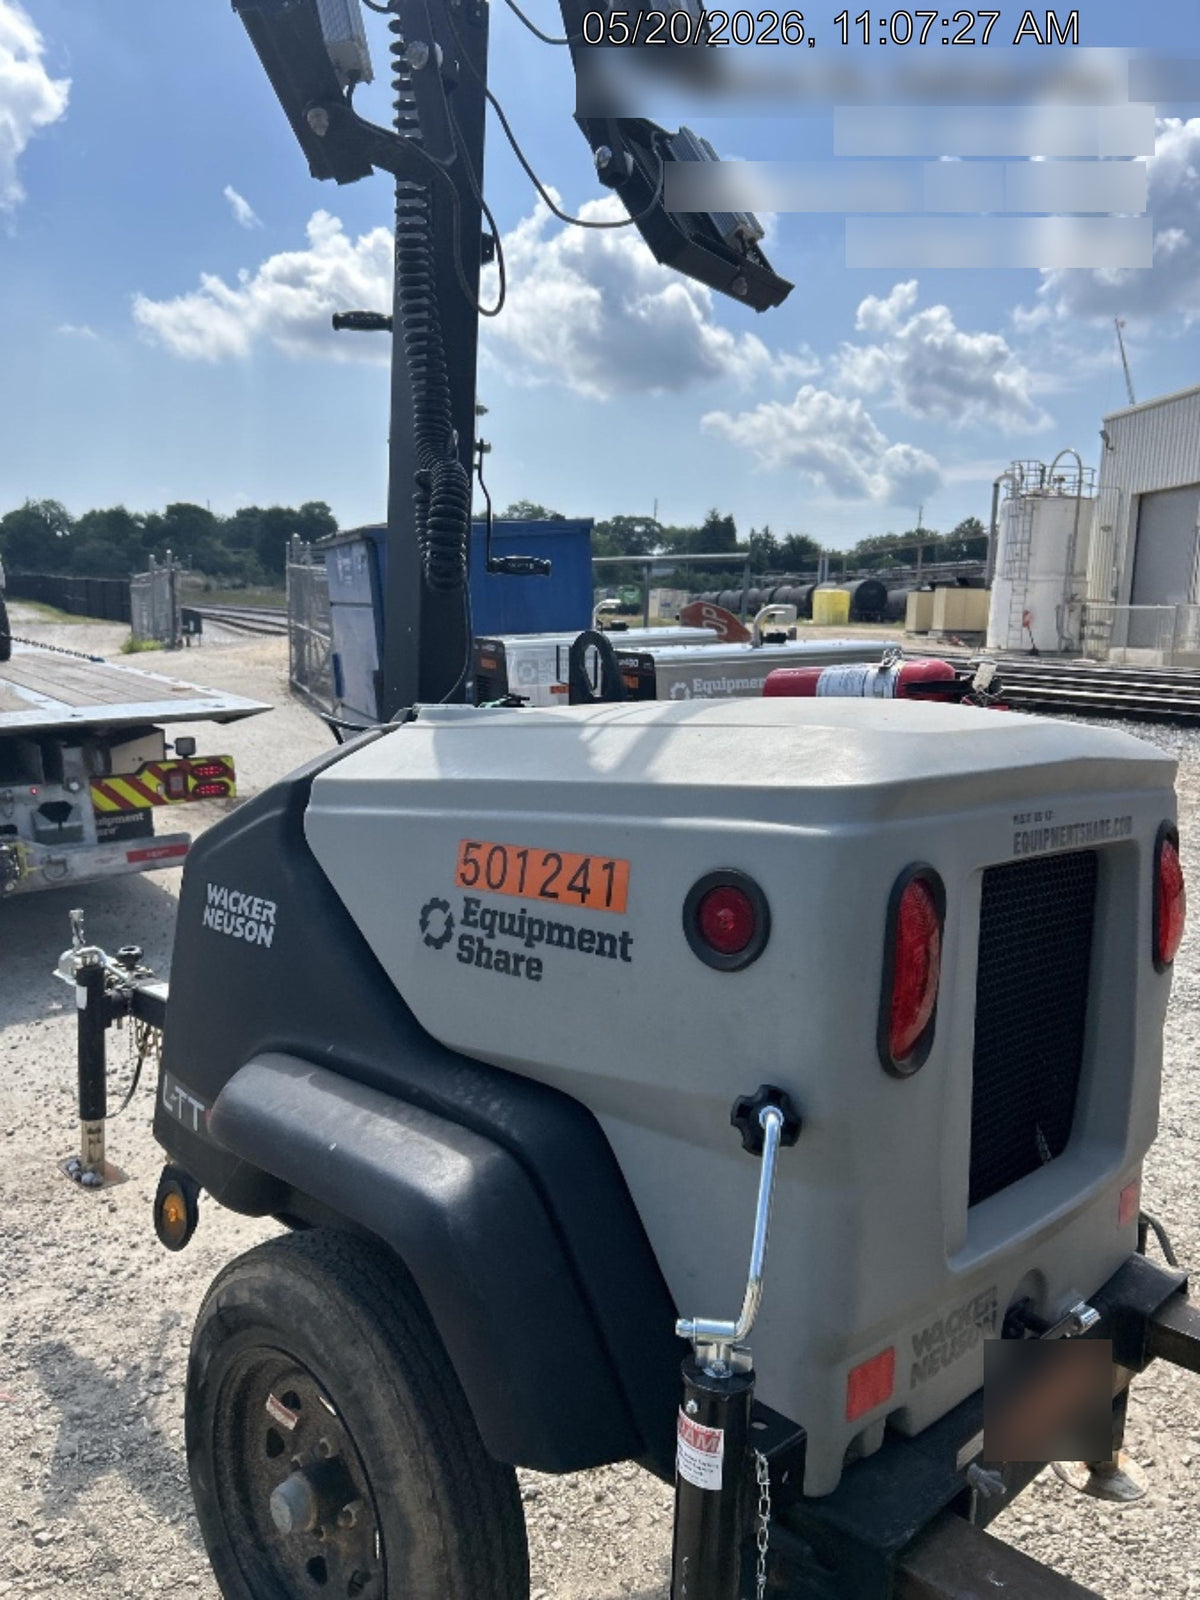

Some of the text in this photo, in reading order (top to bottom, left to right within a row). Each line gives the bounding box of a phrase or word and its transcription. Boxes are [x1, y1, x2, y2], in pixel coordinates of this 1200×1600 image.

[692, 677, 764, 694] Equipme
[459, 841, 616, 908] 501241
[202, 904, 275, 949] NEUSON
[207, 883, 277, 926] WACKER
[460, 896, 634, 962] Equipment
[456, 933, 544, 982] Share
